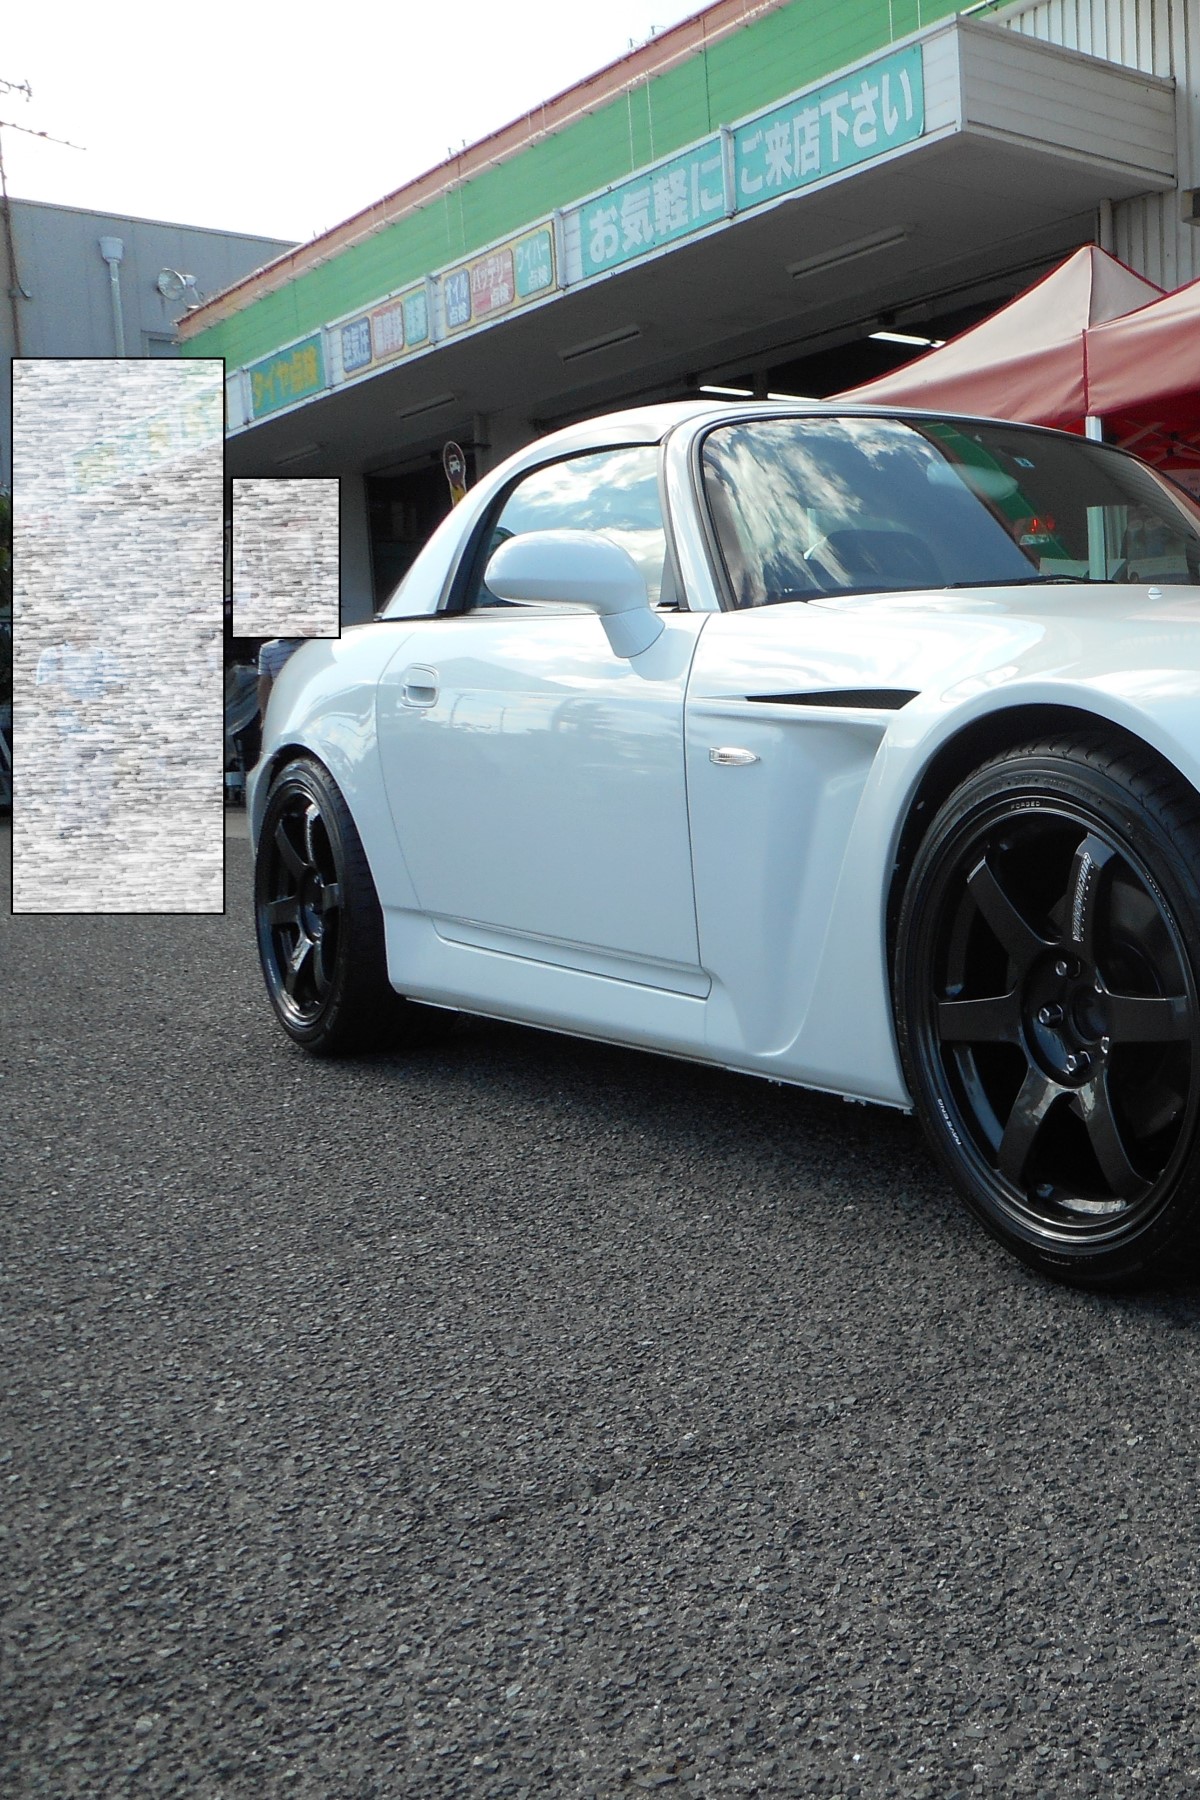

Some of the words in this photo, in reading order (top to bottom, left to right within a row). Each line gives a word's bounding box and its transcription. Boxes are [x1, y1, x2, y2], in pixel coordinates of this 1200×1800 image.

[588, 155, 723, 264] お気軽に
[740, 69, 914, 195] ご来店下さい
[1010, 801, 1041, 810] FORGED
